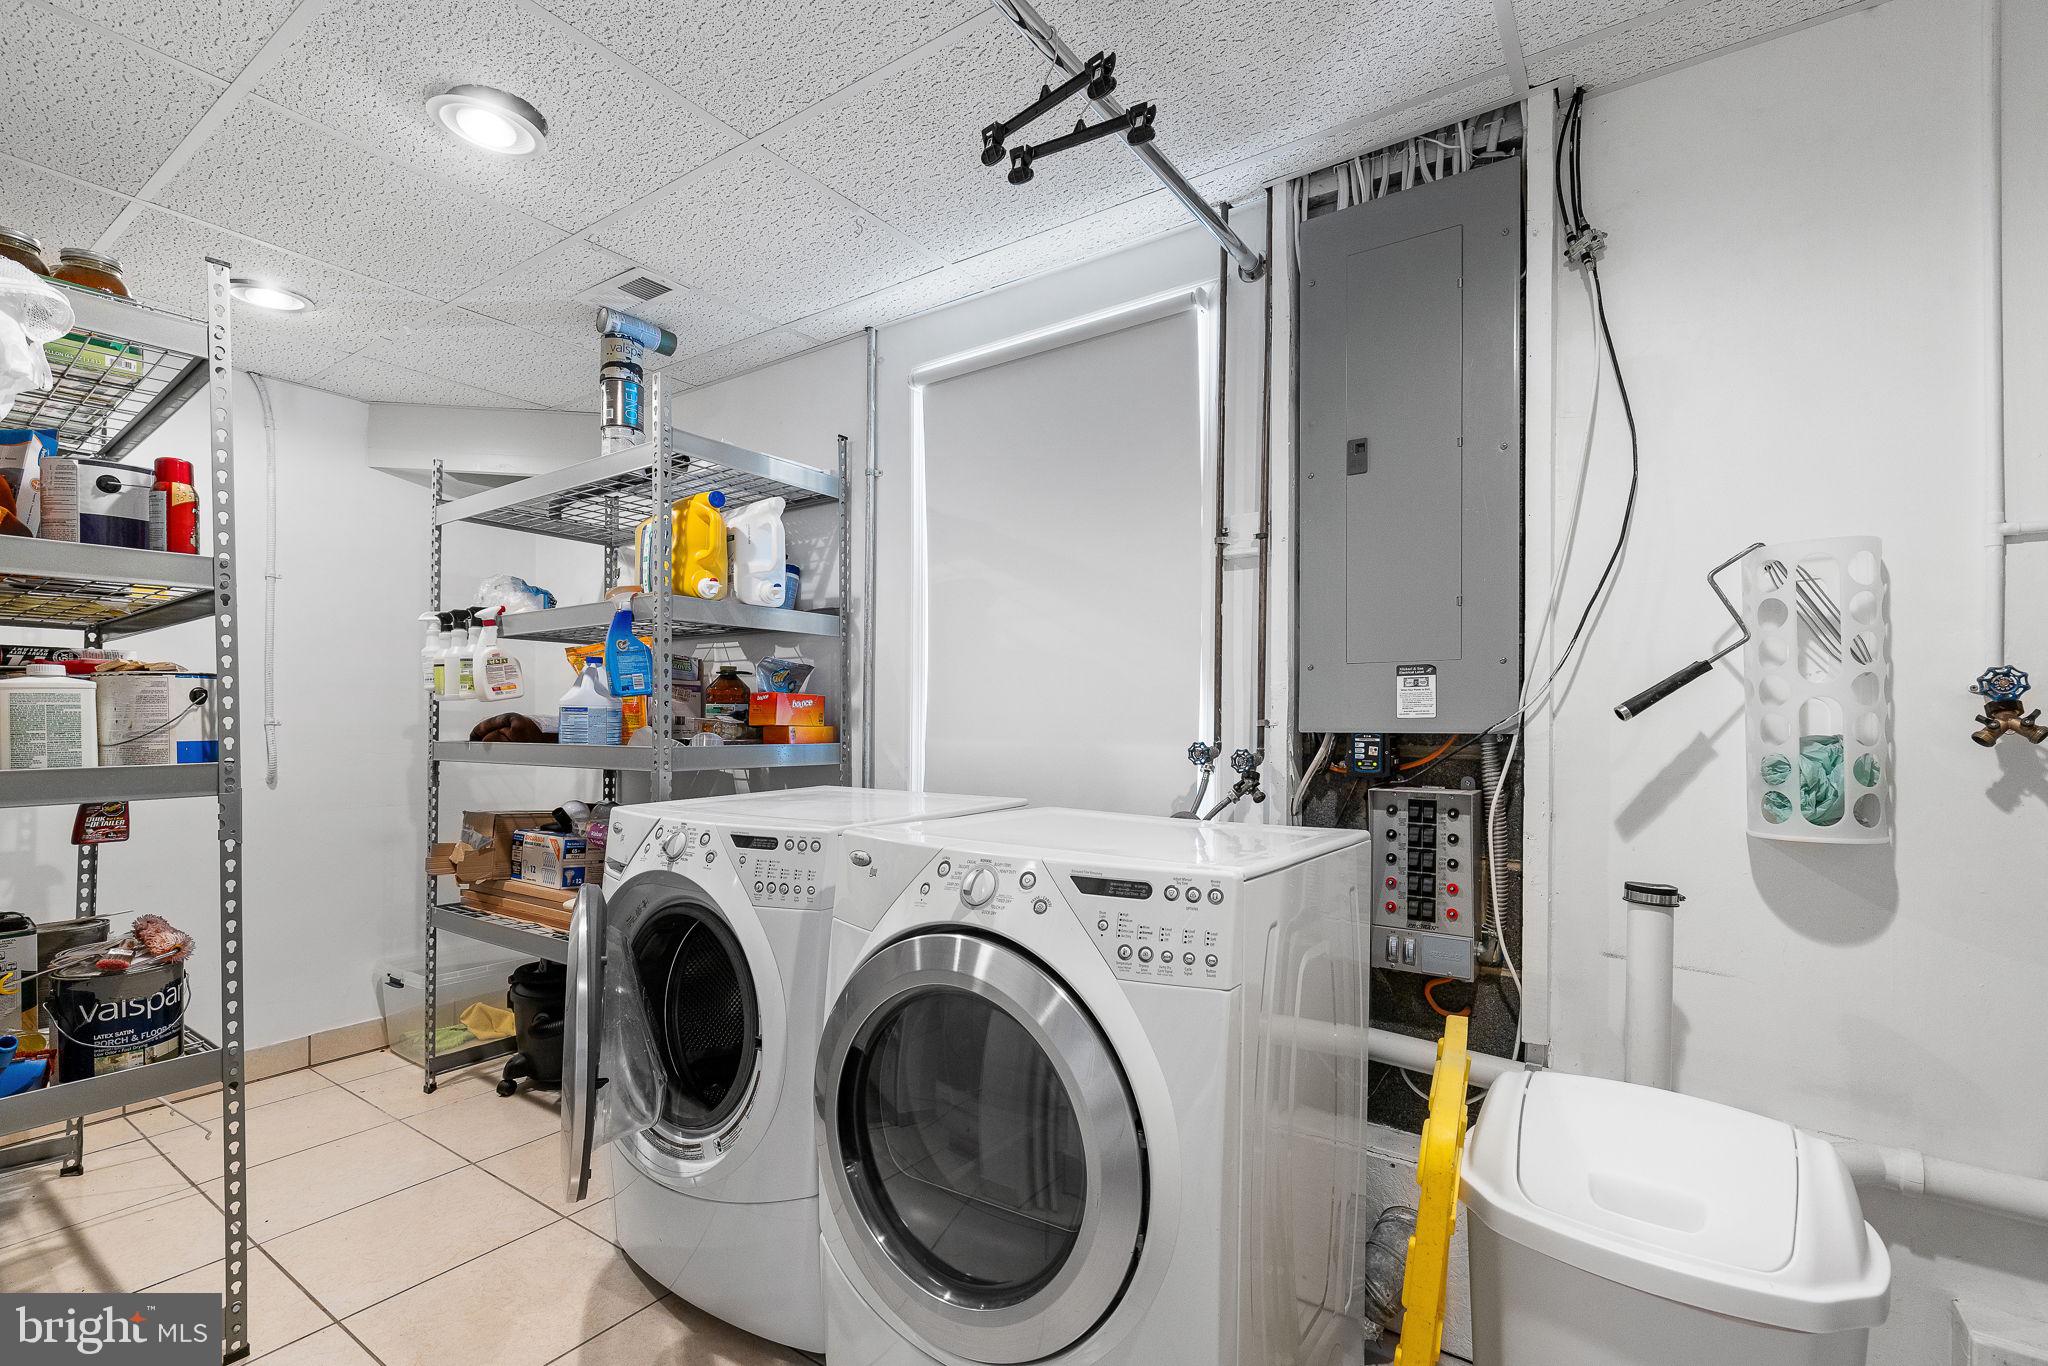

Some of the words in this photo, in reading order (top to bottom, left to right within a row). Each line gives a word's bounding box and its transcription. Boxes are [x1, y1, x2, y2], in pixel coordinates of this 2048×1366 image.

[792, 700, 814, 708] bounce
[530, 864, 536, 874] 12
[79, 982, 182, 1023] valspar
[94, 1032, 114, 1040] LATEX
[114, 1028, 134, 1037] SATIN
[94, 1036, 128, 1047] PORCH
